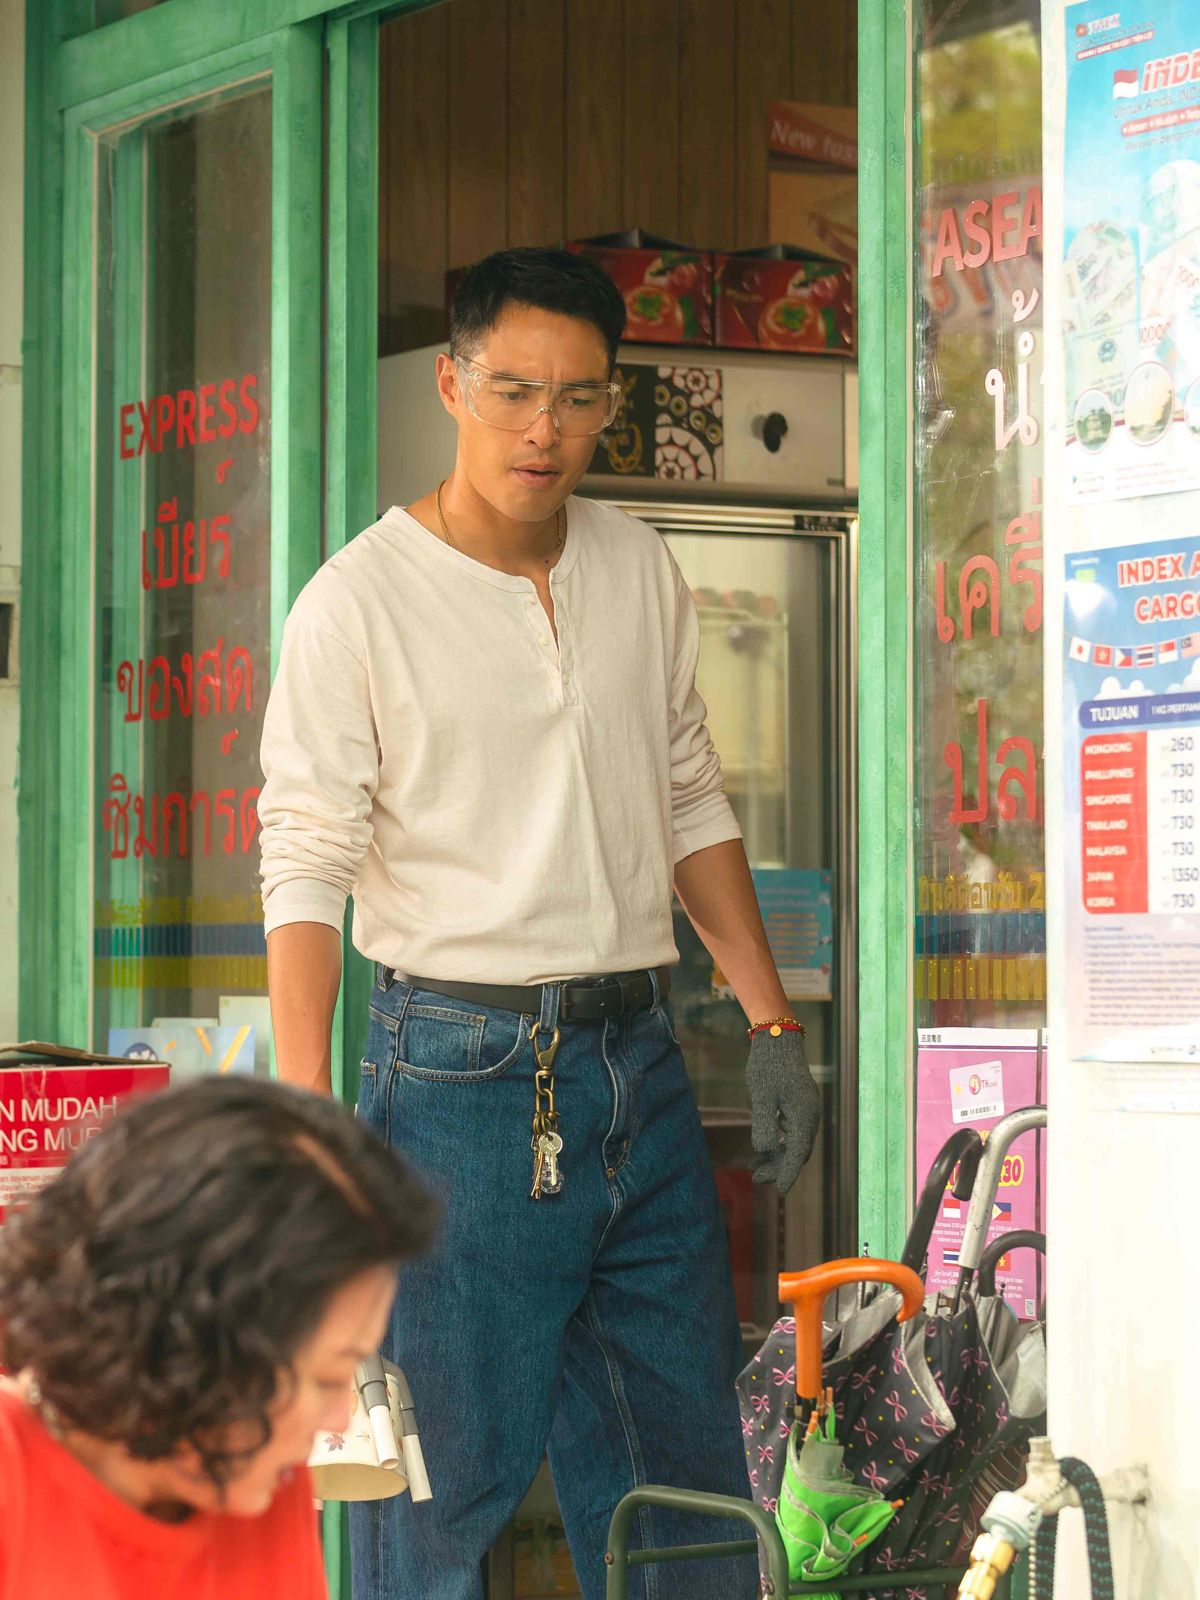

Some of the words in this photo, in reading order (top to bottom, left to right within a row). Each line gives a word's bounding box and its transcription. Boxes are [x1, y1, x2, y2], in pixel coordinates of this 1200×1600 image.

[771, 118, 817, 152] New
[120, 374, 259, 460] EXPRESS
[1118, 554, 1184, 587] INDEX
[1136, 592, 1200, 623] CARG
[1090, 705, 1139, 722] TUJUAN
[21, 1096, 117, 1122] MUDAH
